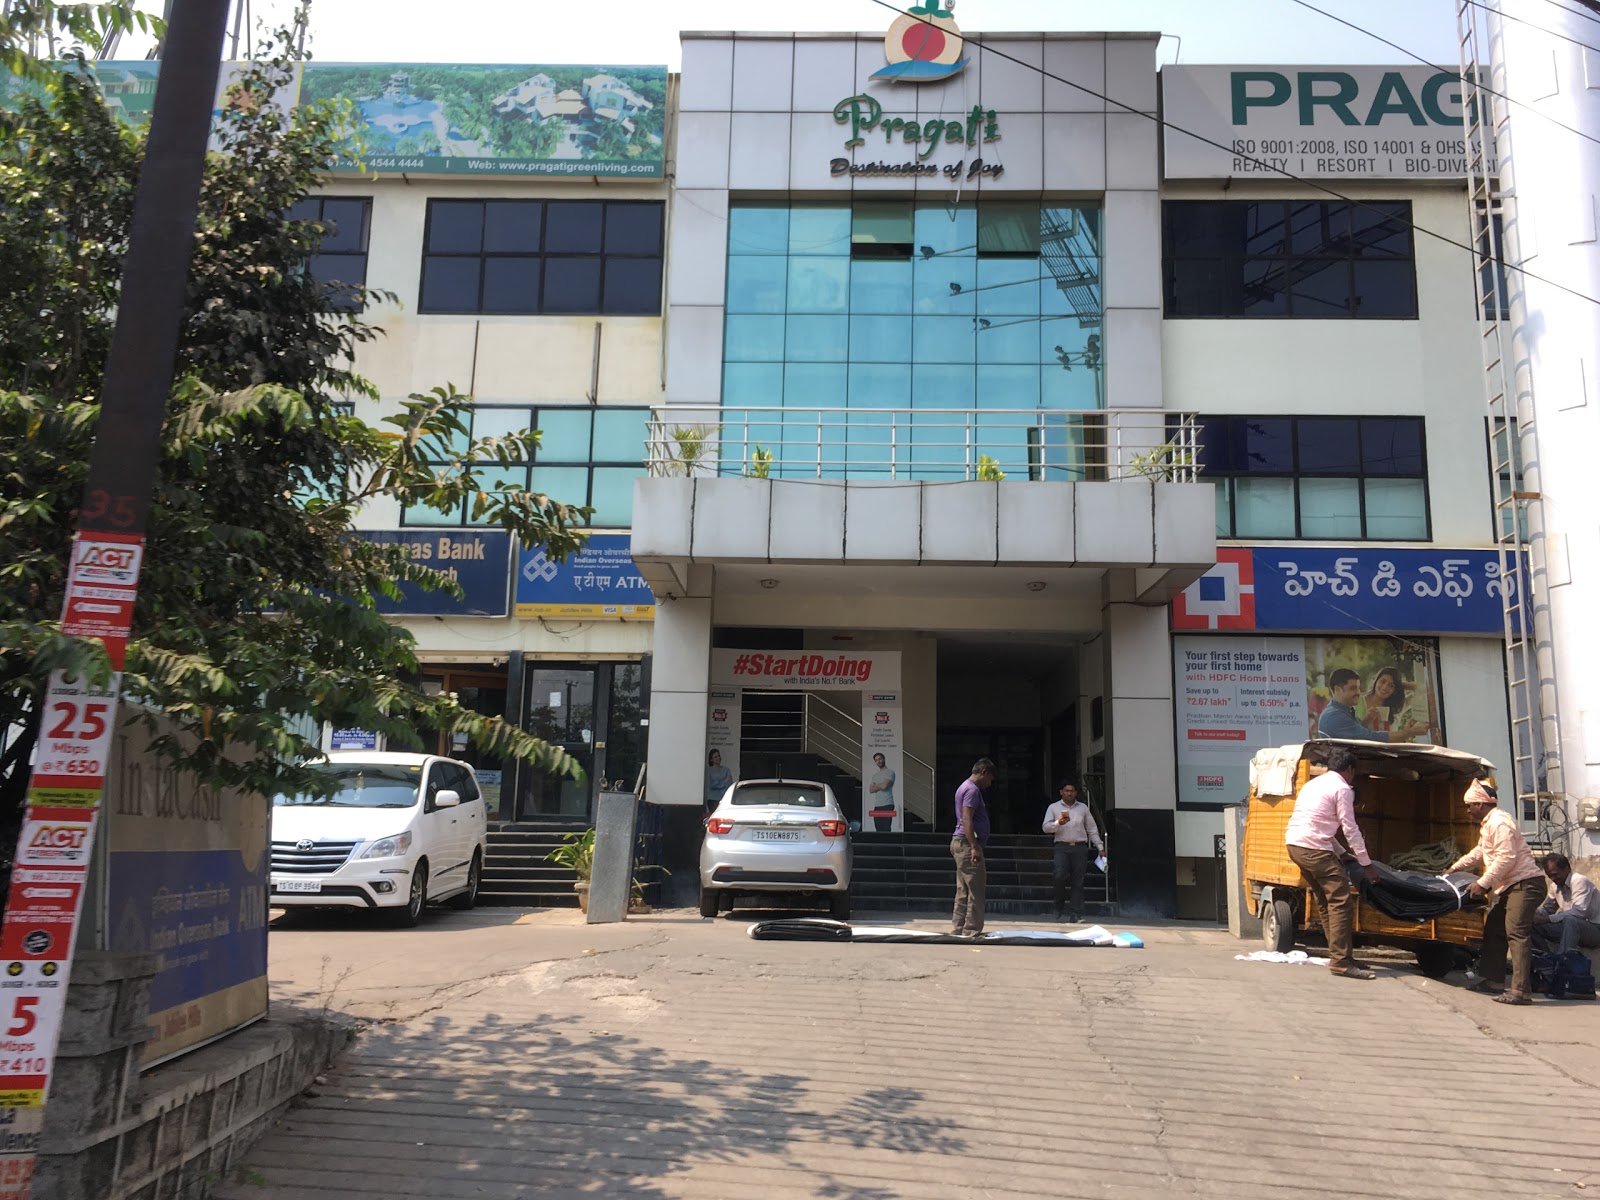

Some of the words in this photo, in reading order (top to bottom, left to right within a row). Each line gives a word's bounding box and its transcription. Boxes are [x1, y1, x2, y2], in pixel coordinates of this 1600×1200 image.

[1231, 72, 1494, 126] PRAG
[832, 93, 1001, 160] Pragati
[1232, 140, 1256, 154] ISO
[1261, 140, 1339, 156] 9001:2008,
[1344, 140, 1368, 154] ISO
[1373, 140, 1414, 154] 14001
[1421, 141, 1431, 154] &
[369, 159, 395, 168] 4544
[398, 159, 424, 168] 4444
[468, 160, 496, 170] Web:
[499, 161, 655, 174] www.pragatigreenliving.com
[830, 157, 938, 178] Destination
[943, 159, 963, 181] of
[966, 158, 1004, 181] Joy
[1233, 158, 1288, 172] REALTY
[1318, 158, 1376, 172] RESORT
[1406, 159, 1498, 173] BIO-DIVERSI
[437, 537, 485, 560] Bank
[80, 546, 135, 569] ACT
[616, 577, 651, 589] ATM
[1185, 651, 1207, 660] Your
[1210, 651, 1231, 660] first
[1234, 652, 1255, 662] step
[1258, 652, 1299, 662] towards
[733, 654, 872, 681] #StartDoing
[1185, 662, 1207, 672] your
[1211, 662, 1231, 670] first
[1234, 662, 1262, 671] home
[800, 677, 820, 685] India's
[839, 677, 855, 685] Bank
[1185, 673, 1205, 681] with
[1240, 674, 1267, 682] Home
[1271, 675, 1300, 683] Loans
[1266, 688, 1291, 697] subsidy
[1187, 697, 1208, 706] ₹2.67
[1241, 700, 1249, 708] up
[48, 701, 107, 740] 25
[52, 743, 90, 755] Mbps
[28, 825, 88, 848] ACT
[6, 996, 40, 1037] 5
